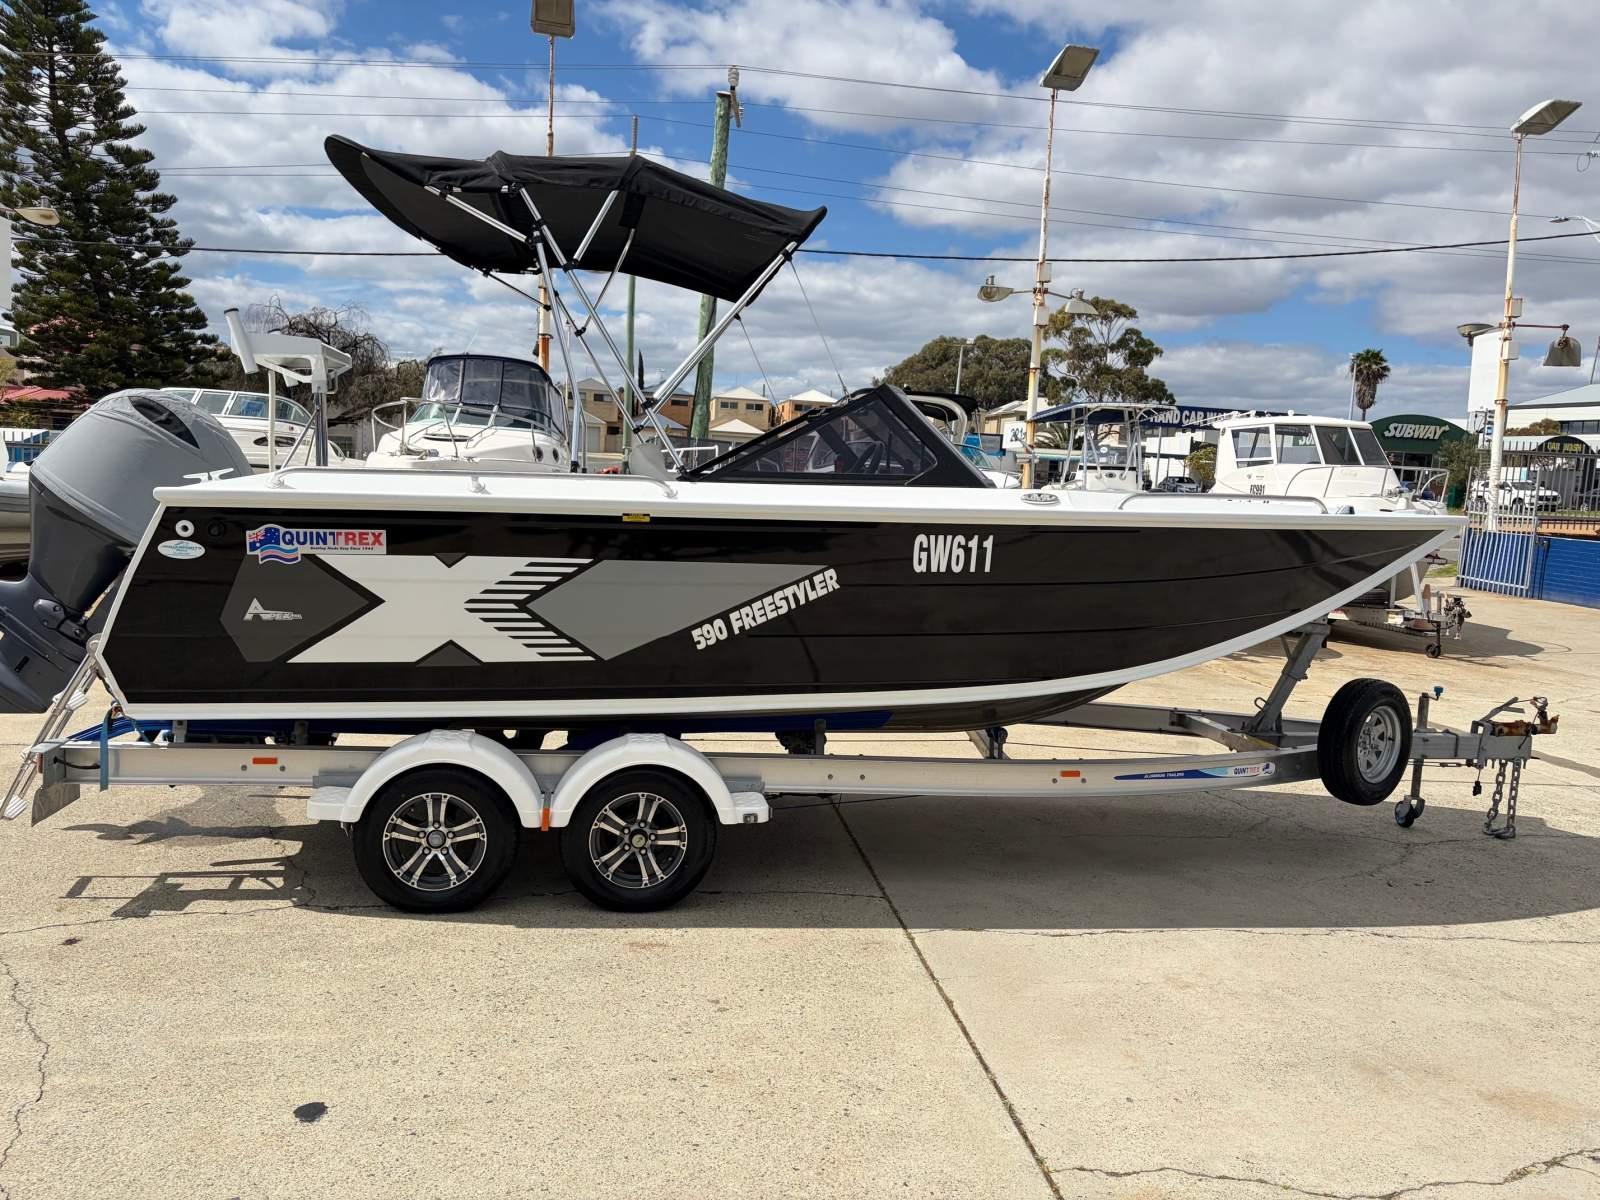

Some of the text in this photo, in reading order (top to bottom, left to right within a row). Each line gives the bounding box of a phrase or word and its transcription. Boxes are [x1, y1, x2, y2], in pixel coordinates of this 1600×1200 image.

[1182, 410, 1205, 426] CAR
[1384, 423, 1449, 440] SUBWAY
[281, 530, 384, 546] QUINTREX
[913, 533, 994, 573] GW611
[691, 568, 840, 650] 590 FREESTYLER
[1233, 767, 1261, 775] QUINTREX
